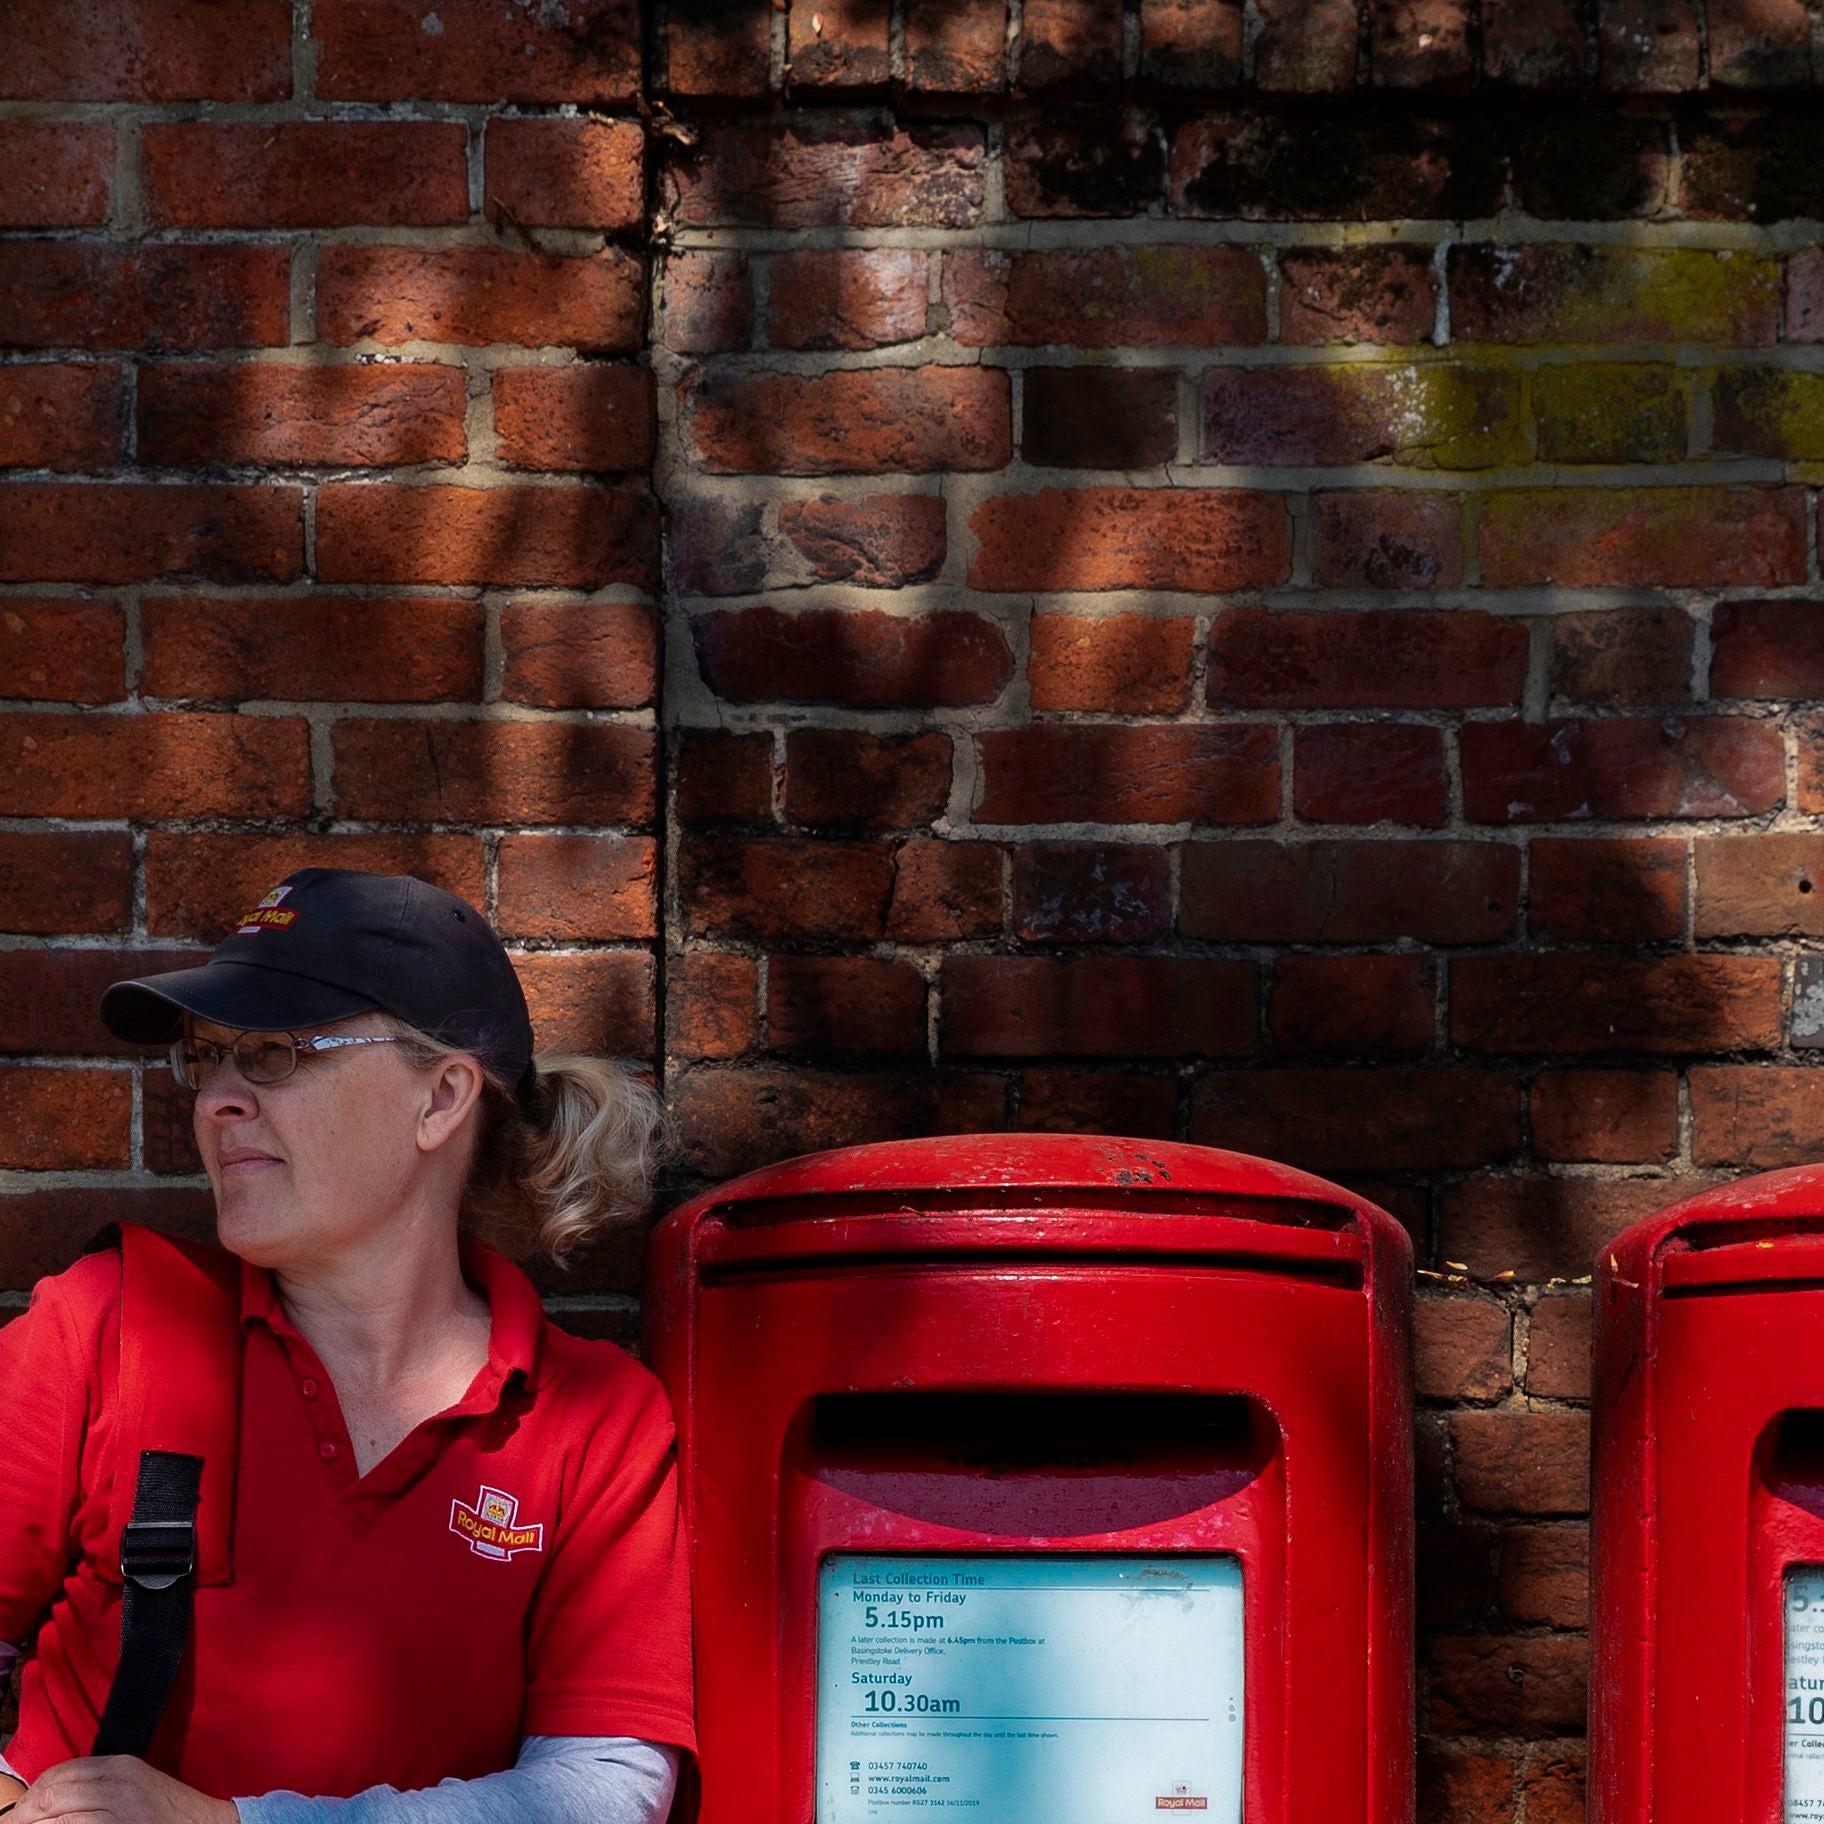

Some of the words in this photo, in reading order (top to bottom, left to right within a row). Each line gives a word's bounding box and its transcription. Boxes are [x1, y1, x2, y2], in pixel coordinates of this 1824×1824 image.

[457, 1510, 496, 1541] Royal
[498, 1530, 535, 1546] Mail
[853, 1573, 881, 1585] Last
[886, 1573, 948, 1586] Collection
[952, 1573, 985, 1586] Time
[853, 1591, 903, 1606] Monday
[909, 1592, 921, 1603] to
[926, 1591, 966, 1606] Friday
[865, 1606, 944, 1632] 5.15pm
[1790, 1625, 1811, 1635] ater
[851, 1636, 857, 1644] A
[857, 1636, 874, 1644] later
[875, 1636, 908, 1644] collection
[910, 1636, 915, 1644] is
[917, 1636, 936, 1645] made
[938, 1637, 946, 1645] at
[947, 1637, 976, 1646] 6.45pm
[977, 1637, 994, 1645] from
[996, 1637, 1007, 1645] the
[1009, 1637, 1036, 1645] Postbox
[851, 1647, 893, 1656] Basingstoke
[895, 1647, 922, 1656] Delivery
[851, 1657, 881, 1667] Priestley
[1789, 1655, 1819, 1667] estley
[852, 1672, 913, 1686] Saturday
[865, 1690, 961, 1713] 10.30am
[851, 1721, 870, 1729] Other
[872, 1721, 908, 1729] Collections
[1789, 1740, 1798, 1748] er
[868, 1762, 894, 1770] 03457
[897, 1762, 928, 1771] 740740
[868, 1775, 950, 1784] www.royalmail.com
[868, 1786, 889, 1795] 0345
[891, 1787, 927, 1795] 6000606
[1158, 1798, 1184, 1808] Royal
